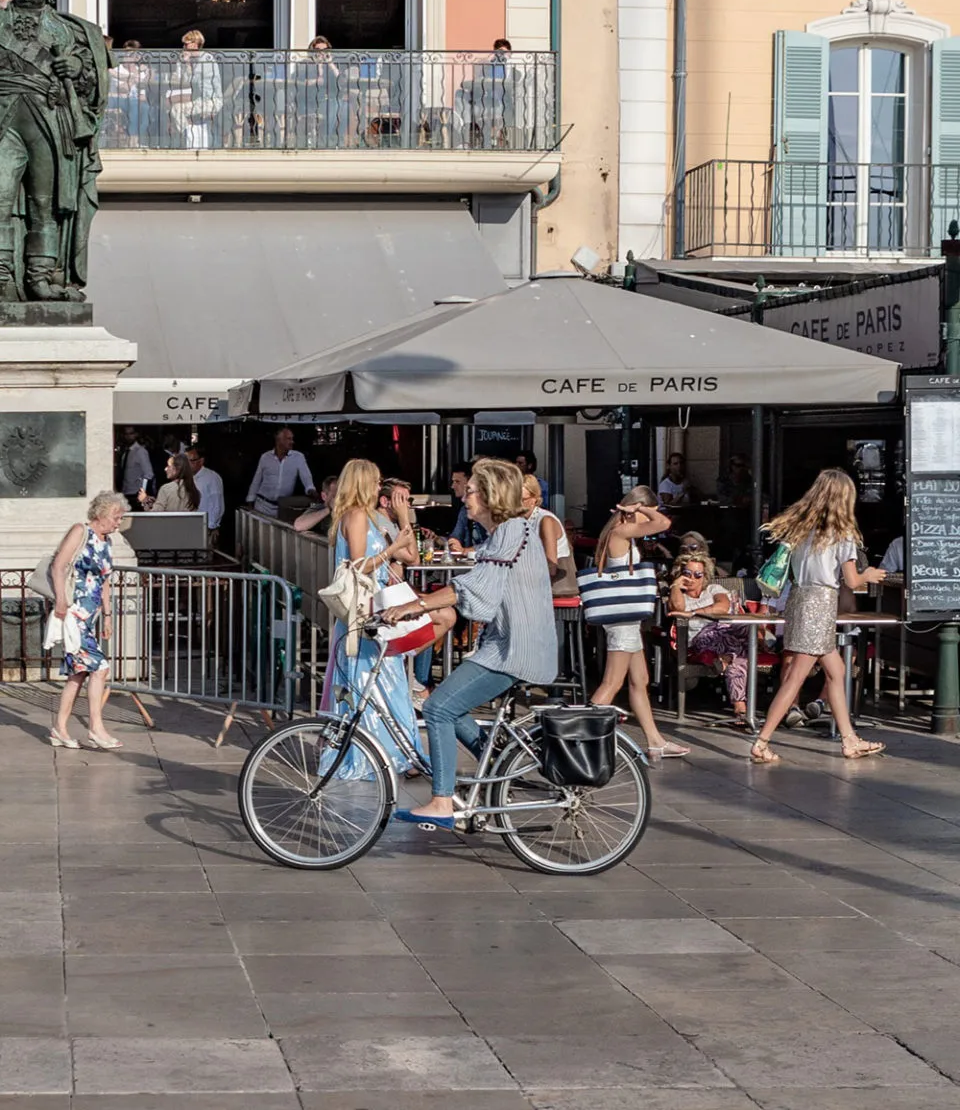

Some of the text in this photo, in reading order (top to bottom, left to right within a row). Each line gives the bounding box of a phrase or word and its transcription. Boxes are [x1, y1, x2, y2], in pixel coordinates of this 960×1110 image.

[836, 322, 850, 340] DE
[856, 304, 902, 337] PARIS
[540, 376, 719, 394] CAFE DE PARIS
[166, 397, 219, 410] CAFE
